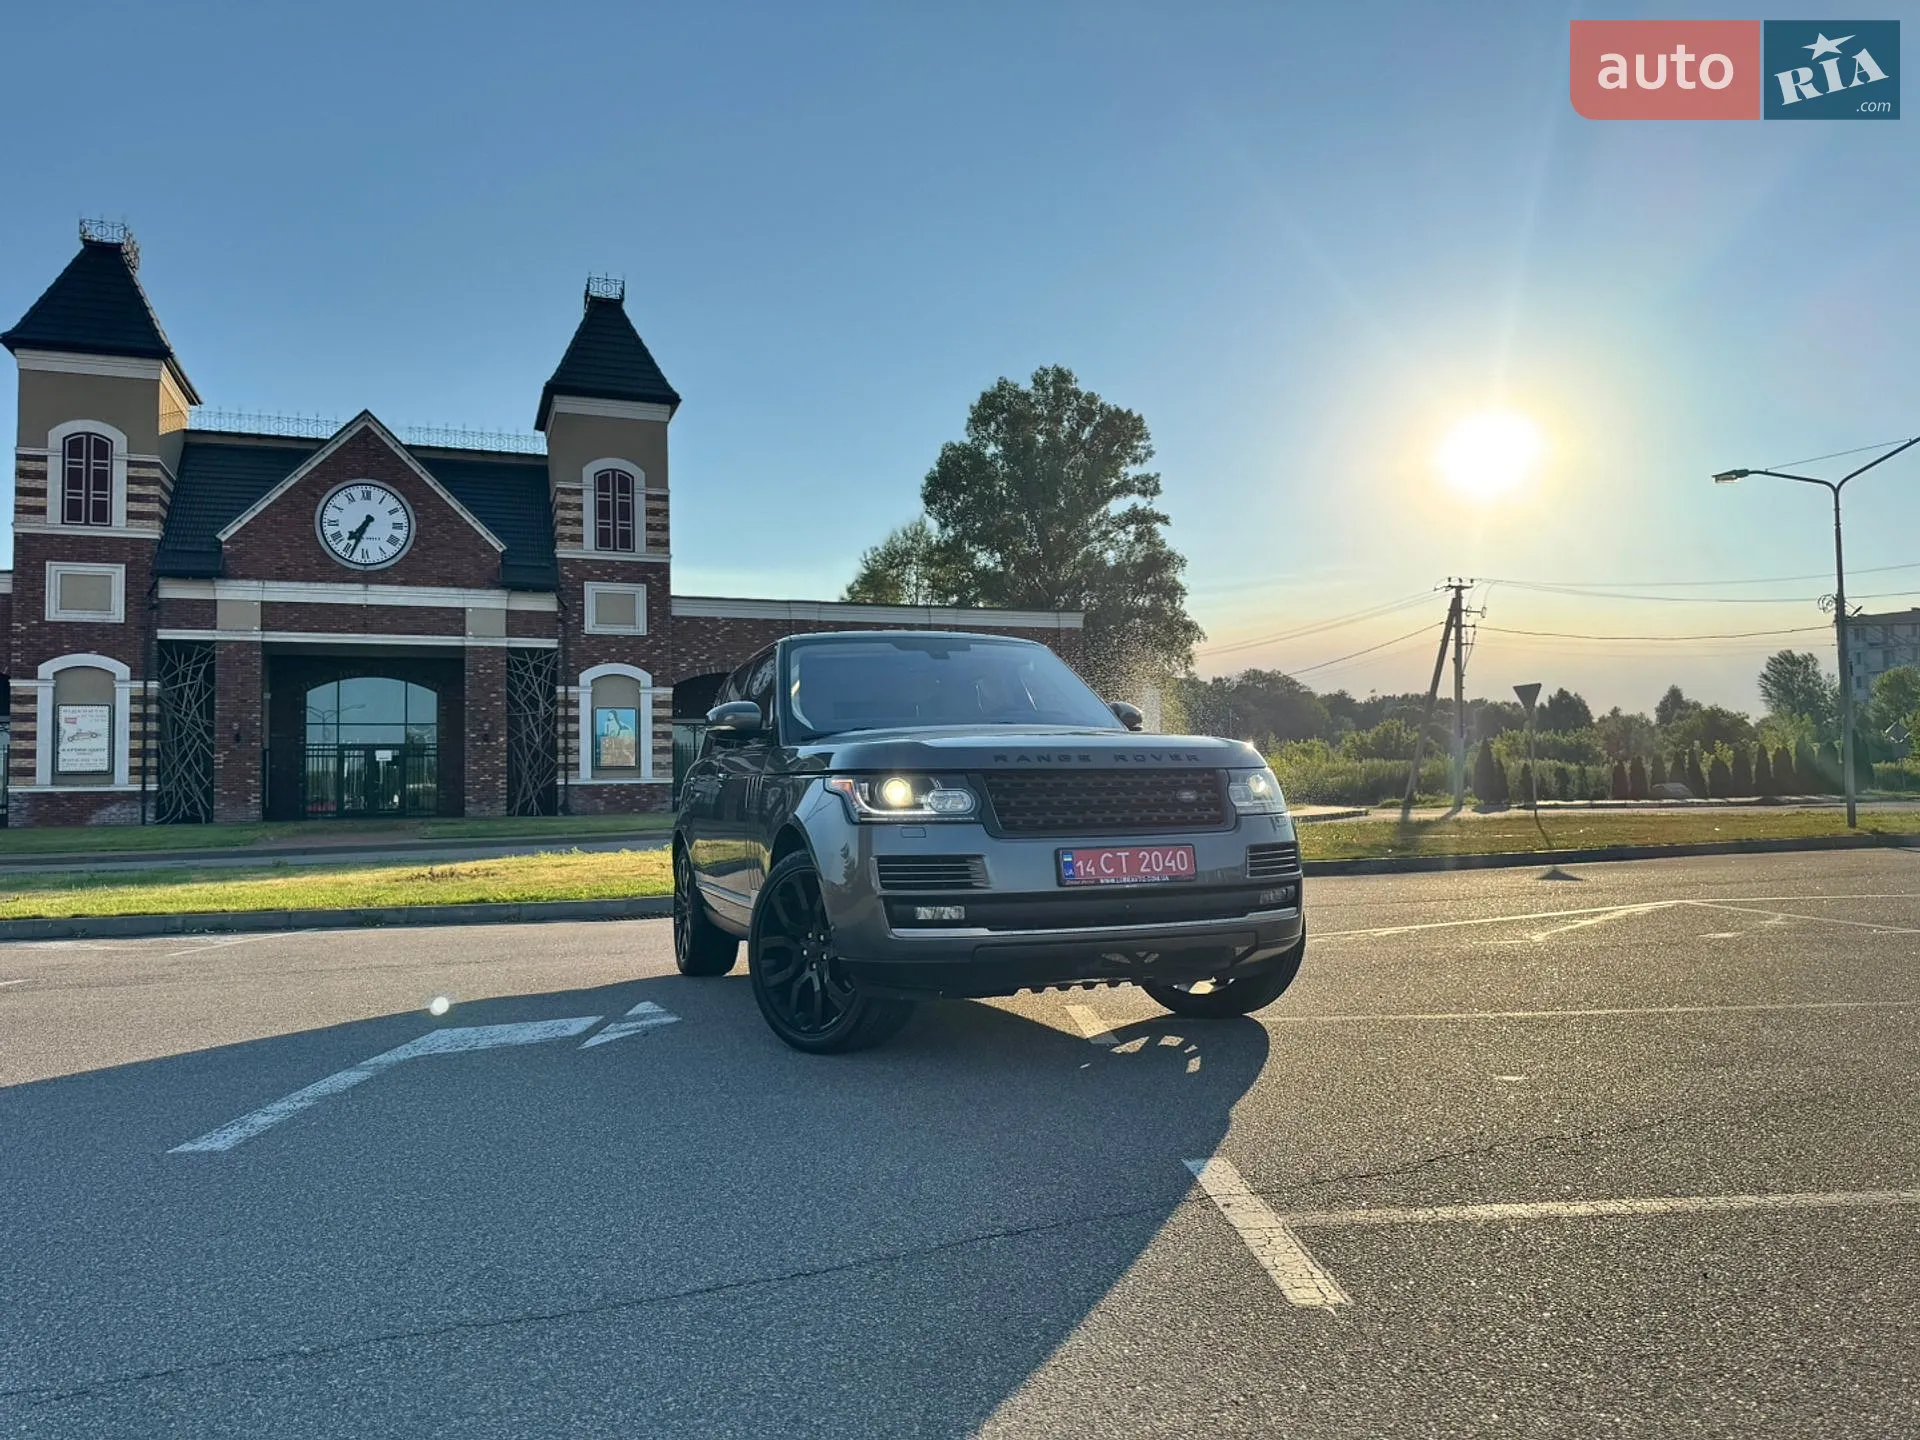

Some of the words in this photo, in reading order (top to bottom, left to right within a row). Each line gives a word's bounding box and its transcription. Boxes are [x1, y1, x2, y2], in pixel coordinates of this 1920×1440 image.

[993, 753, 1093, 763] RANGE
[1113, 752, 1200, 763] ROVER
[1075, 860, 1096, 876] 14
[1099, 852, 1131, 874] CT
[1138, 850, 1189, 873] 2040
